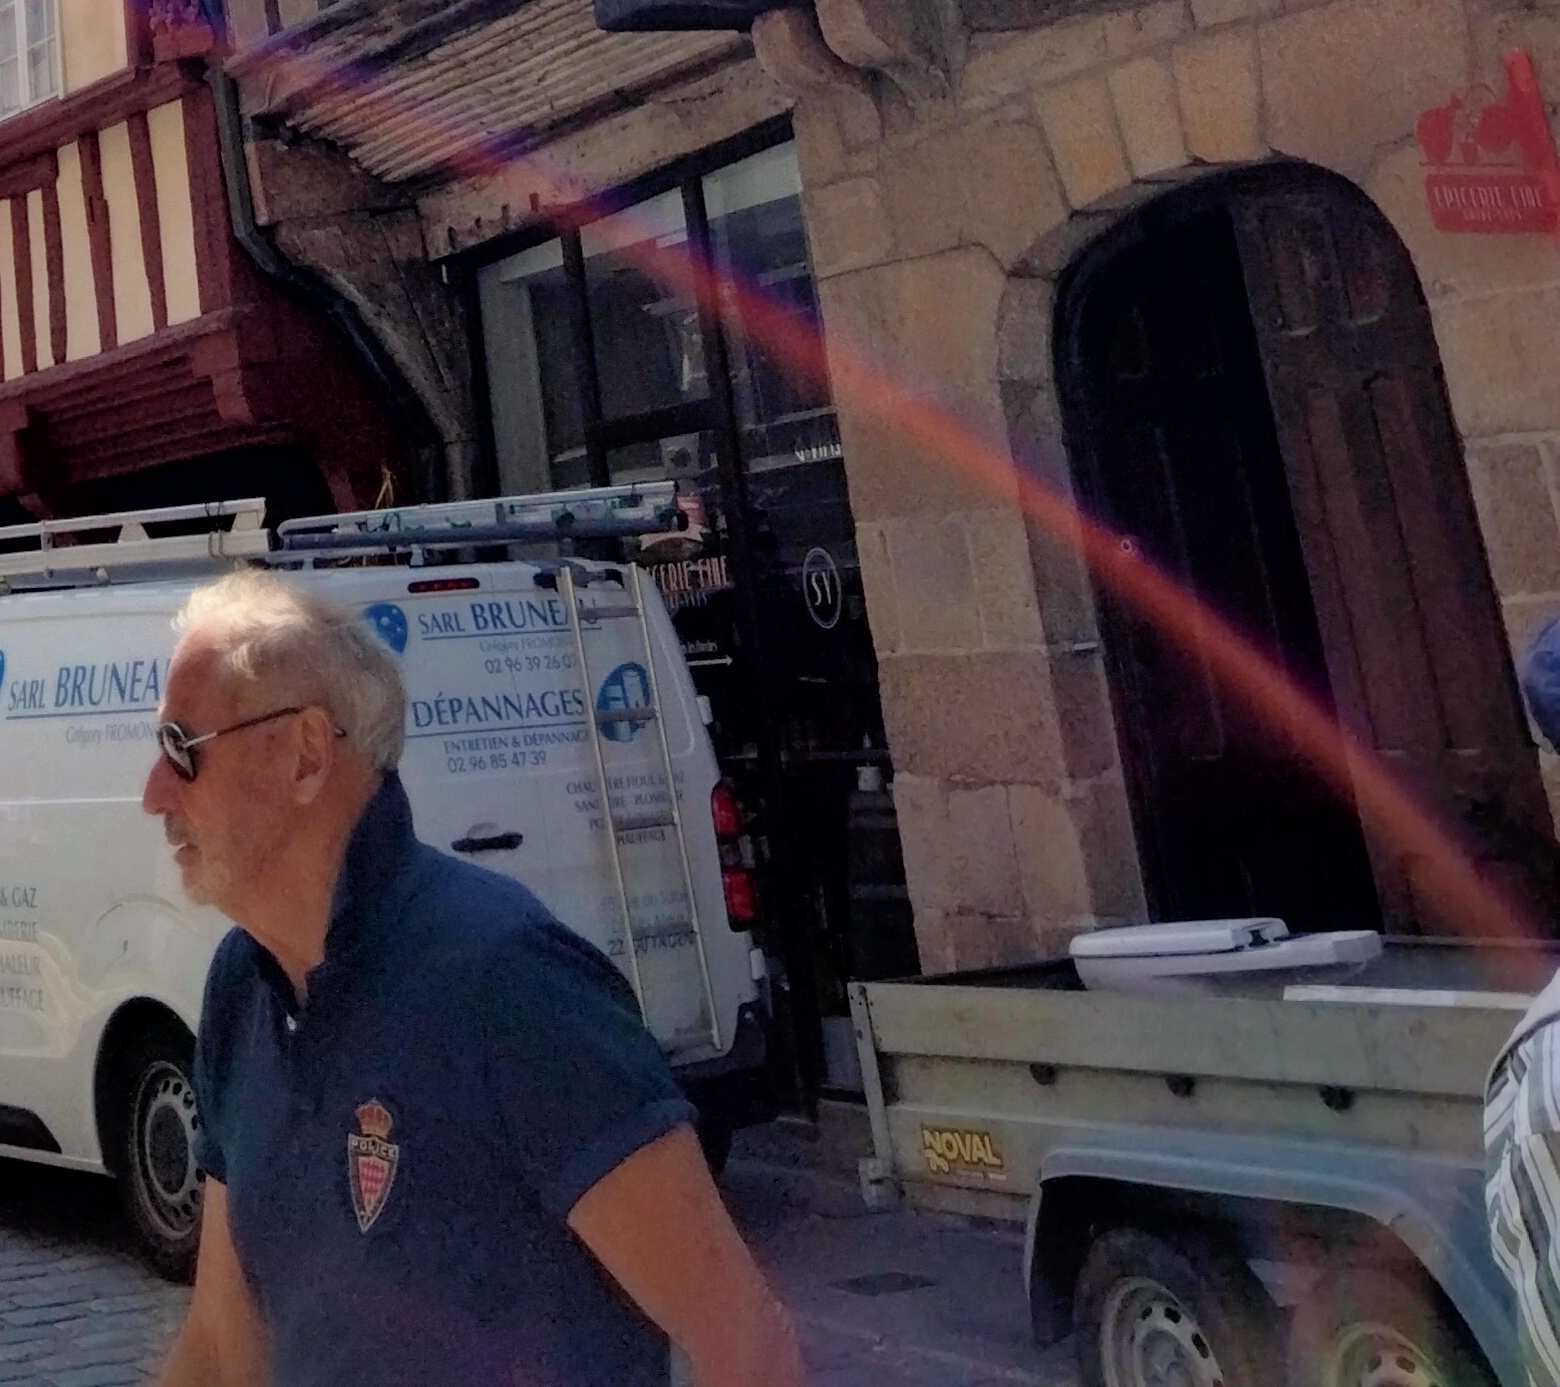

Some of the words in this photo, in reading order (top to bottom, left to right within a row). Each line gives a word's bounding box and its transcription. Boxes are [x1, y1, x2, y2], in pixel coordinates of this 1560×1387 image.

[417, 611, 466, 635] SARL
[484, 658, 502, 674] 02
[505, 657, 523, 673] 96
[525, 655, 541, 672] 39
[545, 654, 561, 670] 26
[8, 678, 46, 711] SARL
[411, 688, 586, 728] DÉPANNAGES
[444, 735, 510, 755] ENTRETIEN
[511, 736, 522, 749] &
[447, 757, 467, 773] 02
[470, 755, 487, 770] 96
[490, 753, 508, 769] 85
[511, 751, 527, 767] 47
[530, 749, 547, 765] 39
[0, 887, 9, 907] &
[11, 887, 38, 909] GAZ
[348, 1135, 398, 1159] POLICE
[923, 1129, 1002, 1166] NOVAL
